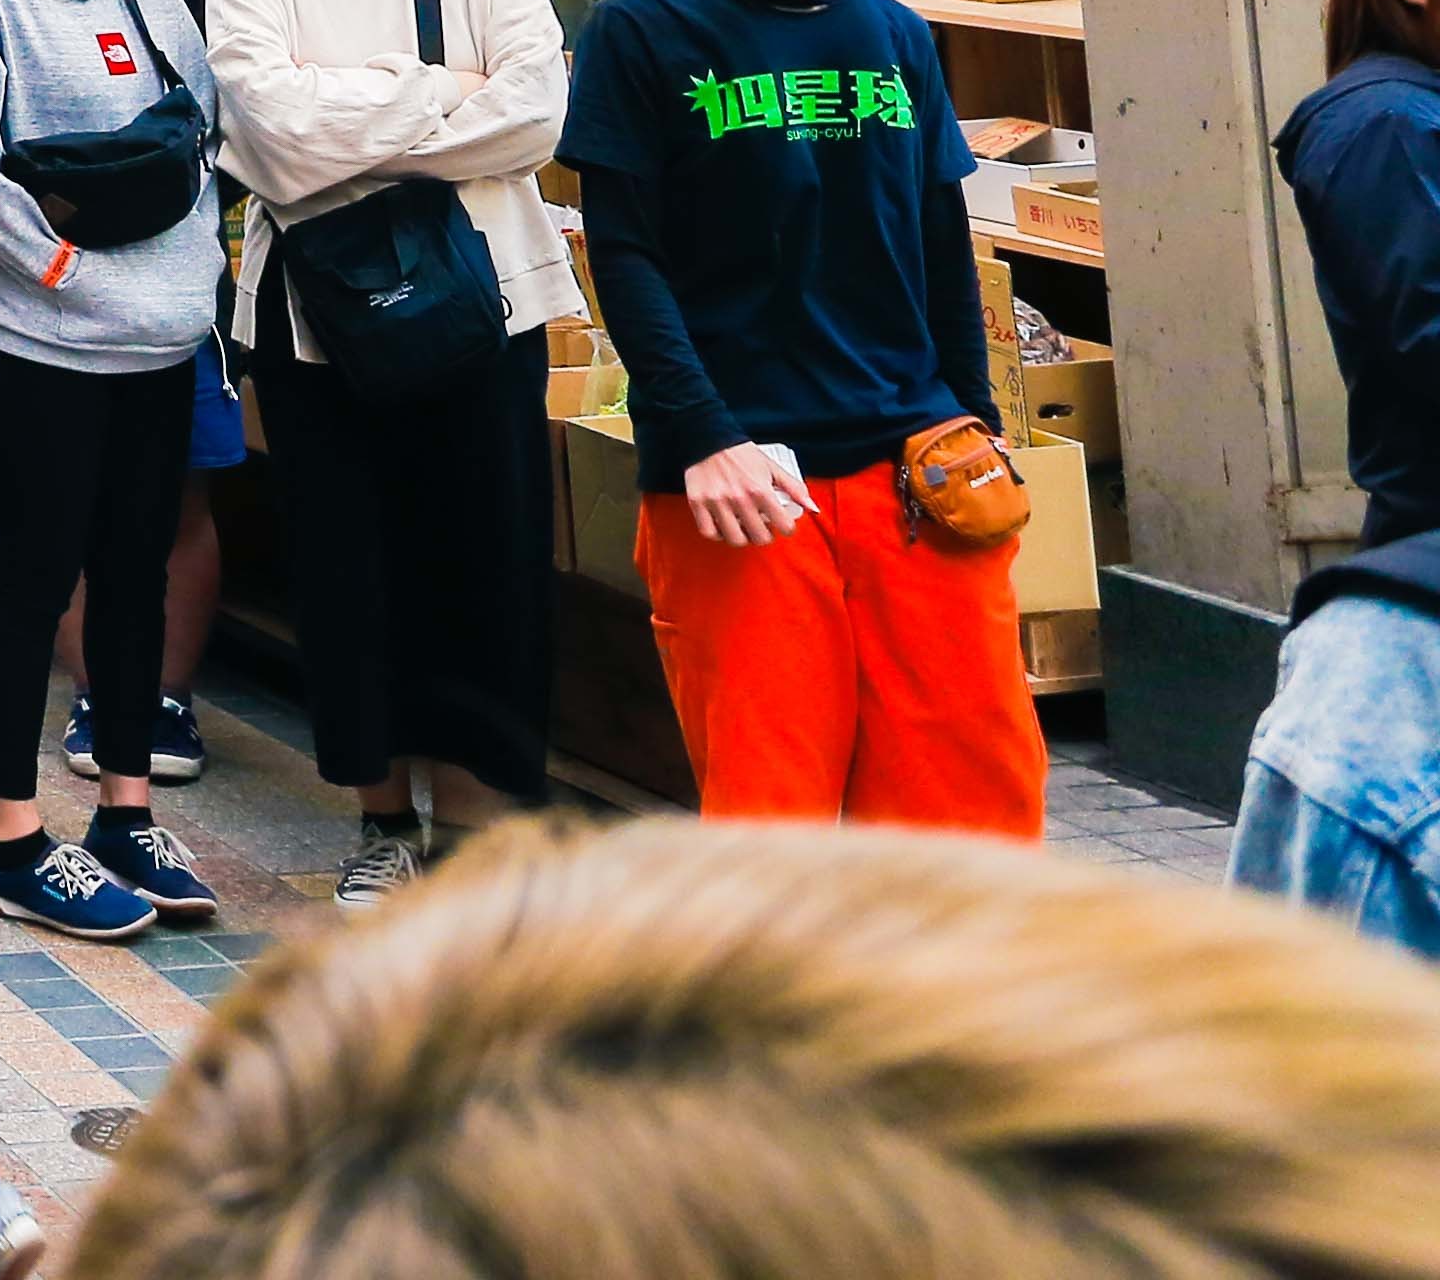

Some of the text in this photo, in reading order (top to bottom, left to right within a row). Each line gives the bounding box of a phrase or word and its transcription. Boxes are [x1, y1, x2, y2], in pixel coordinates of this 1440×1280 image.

[683, 64, 915, 139] 四星球
[1029, 204, 1054, 226] 香川
